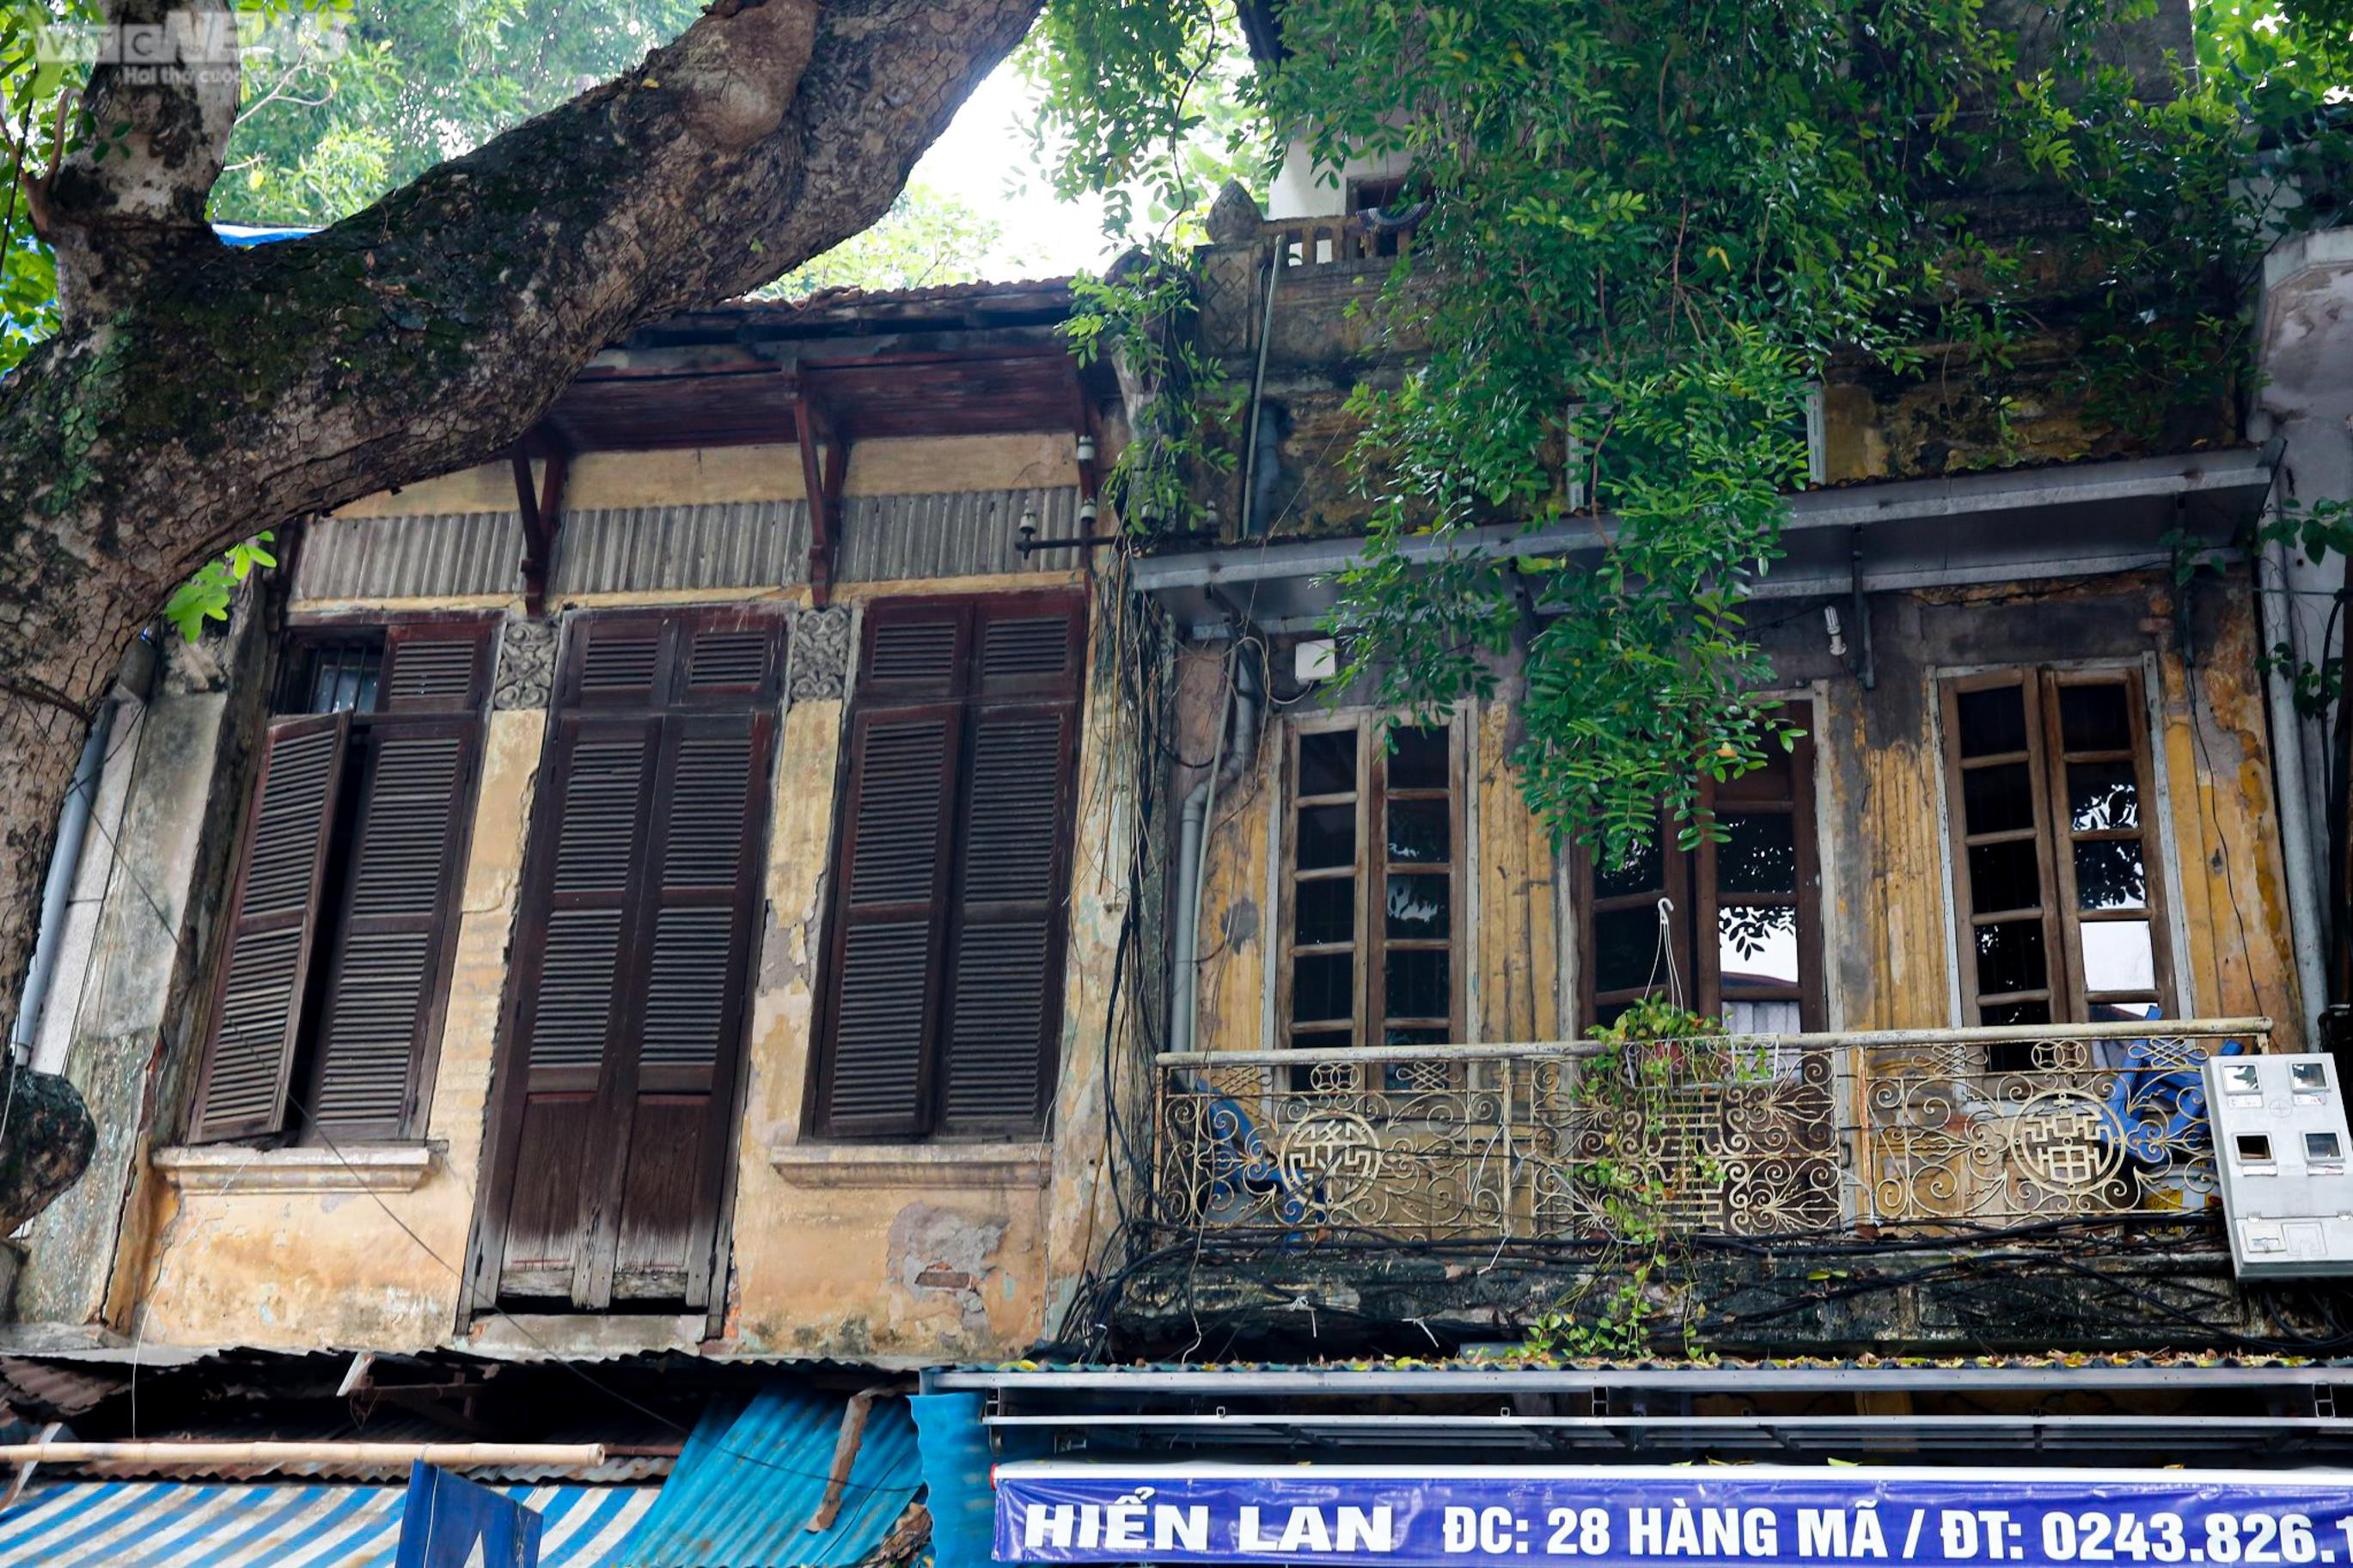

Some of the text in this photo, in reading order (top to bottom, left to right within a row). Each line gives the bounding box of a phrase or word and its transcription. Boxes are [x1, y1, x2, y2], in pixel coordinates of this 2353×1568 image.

[1024, 1486, 1209, 1551] HIỂN
[1238, 1505, 1392, 1553] LAN
[1442, 1506, 1529, 1553] ĐC:
[1547, 1508, 1610, 1555] 28
[1629, 1498, 1778, 1556] HÀNG
[1797, 1499, 1889, 1558] MÃ
[1902, 1509, 1926, 1559] /
[1940, 1510, 2023, 1559] ĐT:
